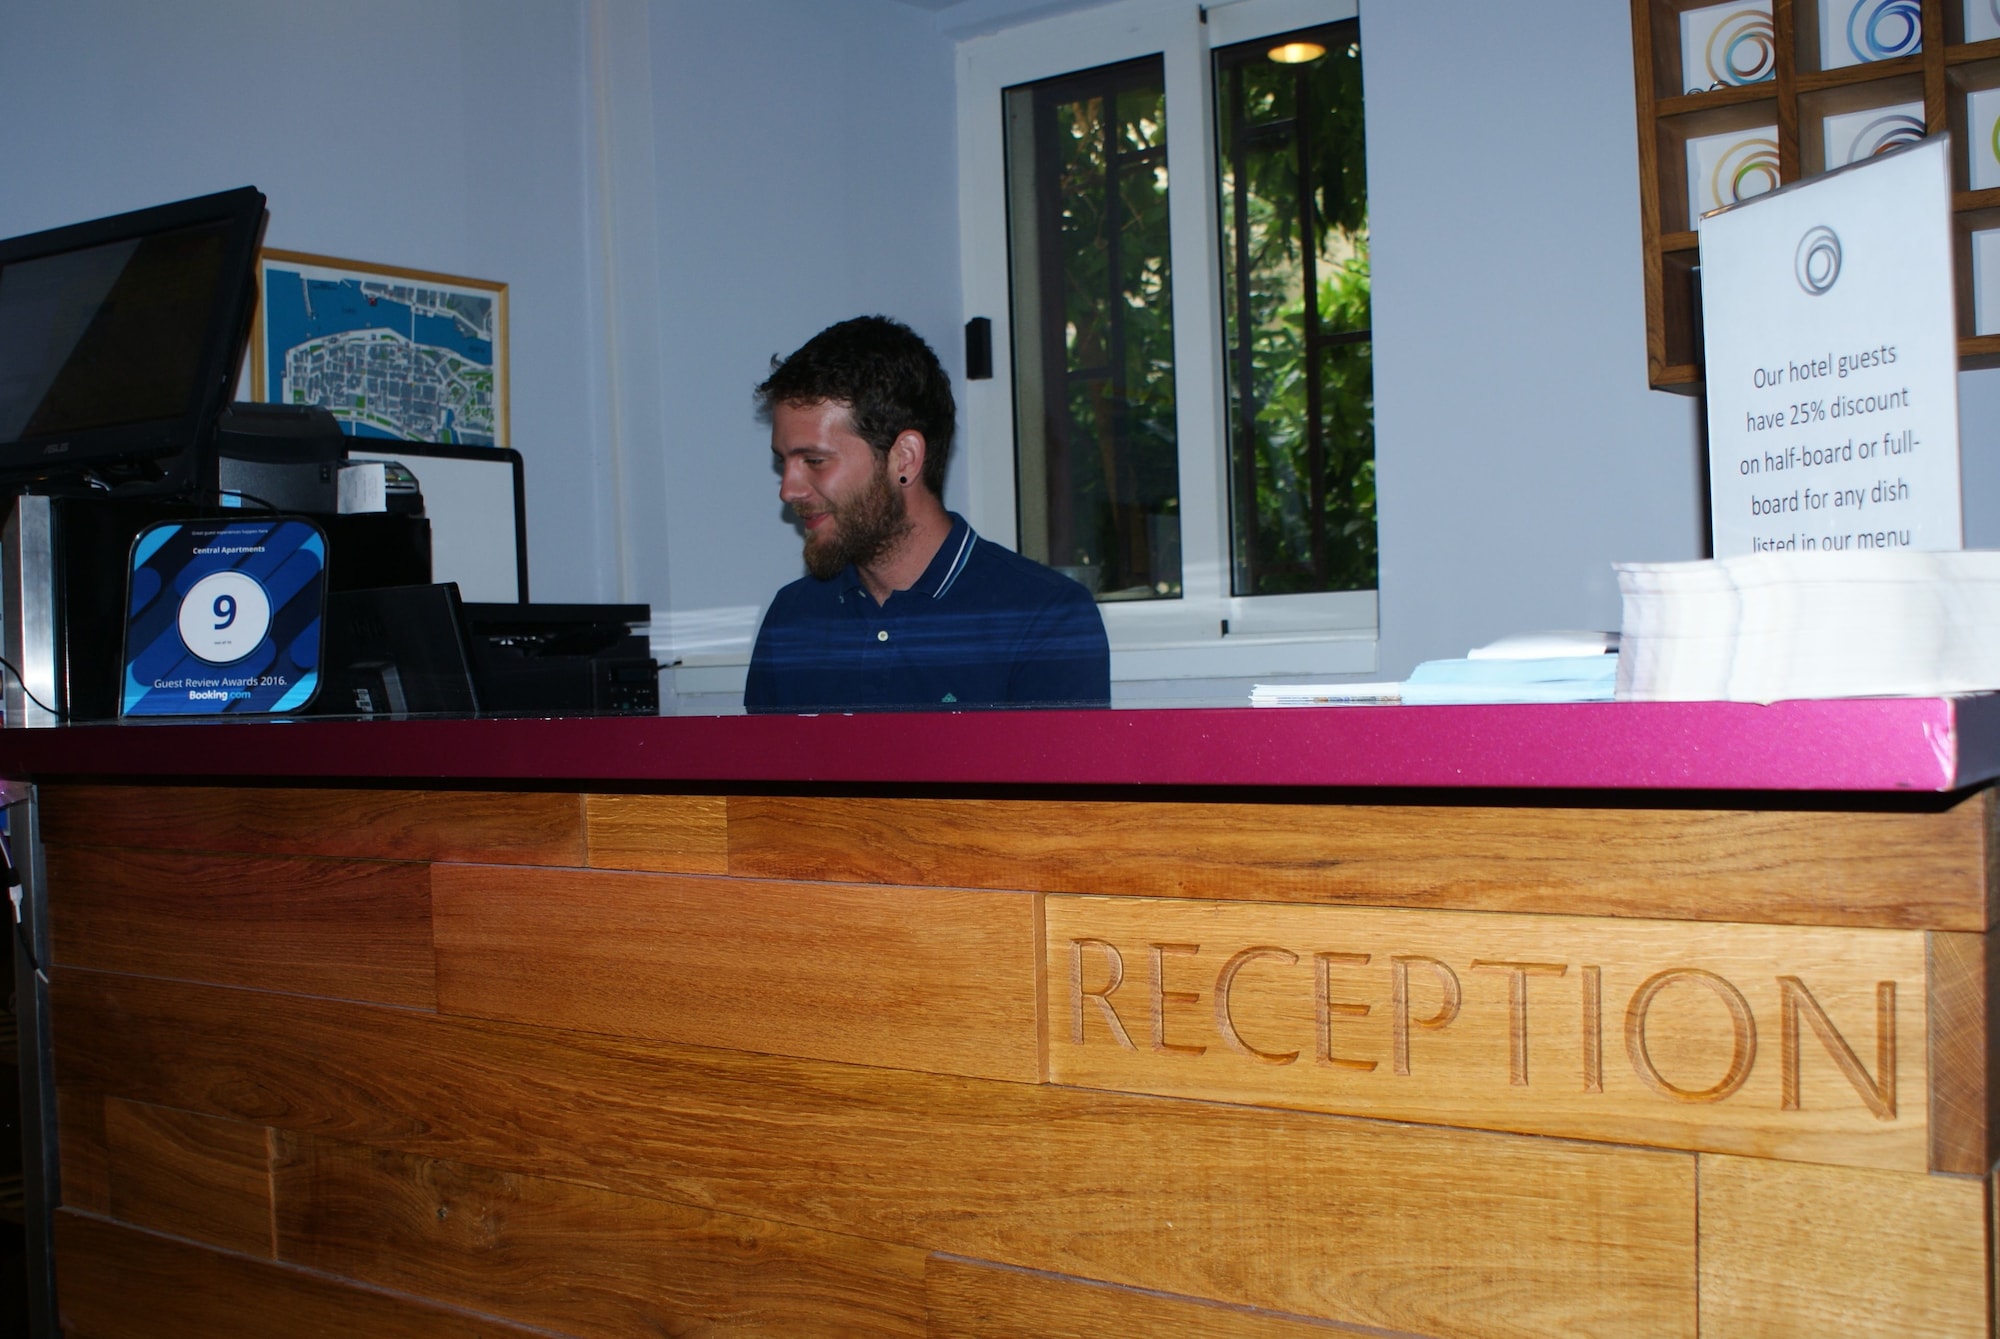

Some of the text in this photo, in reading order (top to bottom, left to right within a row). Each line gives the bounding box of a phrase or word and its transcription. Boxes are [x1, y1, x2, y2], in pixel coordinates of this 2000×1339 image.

[1753, 345, 1897, 389] Our hotel guests
[1746, 387, 1909, 433] have 25% discount
[1740, 430, 1920, 475] on half-board or full-
[1752, 478, 1909, 516] board for any dish
[192, 545, 266, 555] Central Apartments
[1753, 529, 1910, 553] listed in our menu
[213, 594, 237, 630] 9
[154, 676, 288, 689] Guest Review Awards 2016.
[1068, 936, 1898, 1121] RECEPTION
